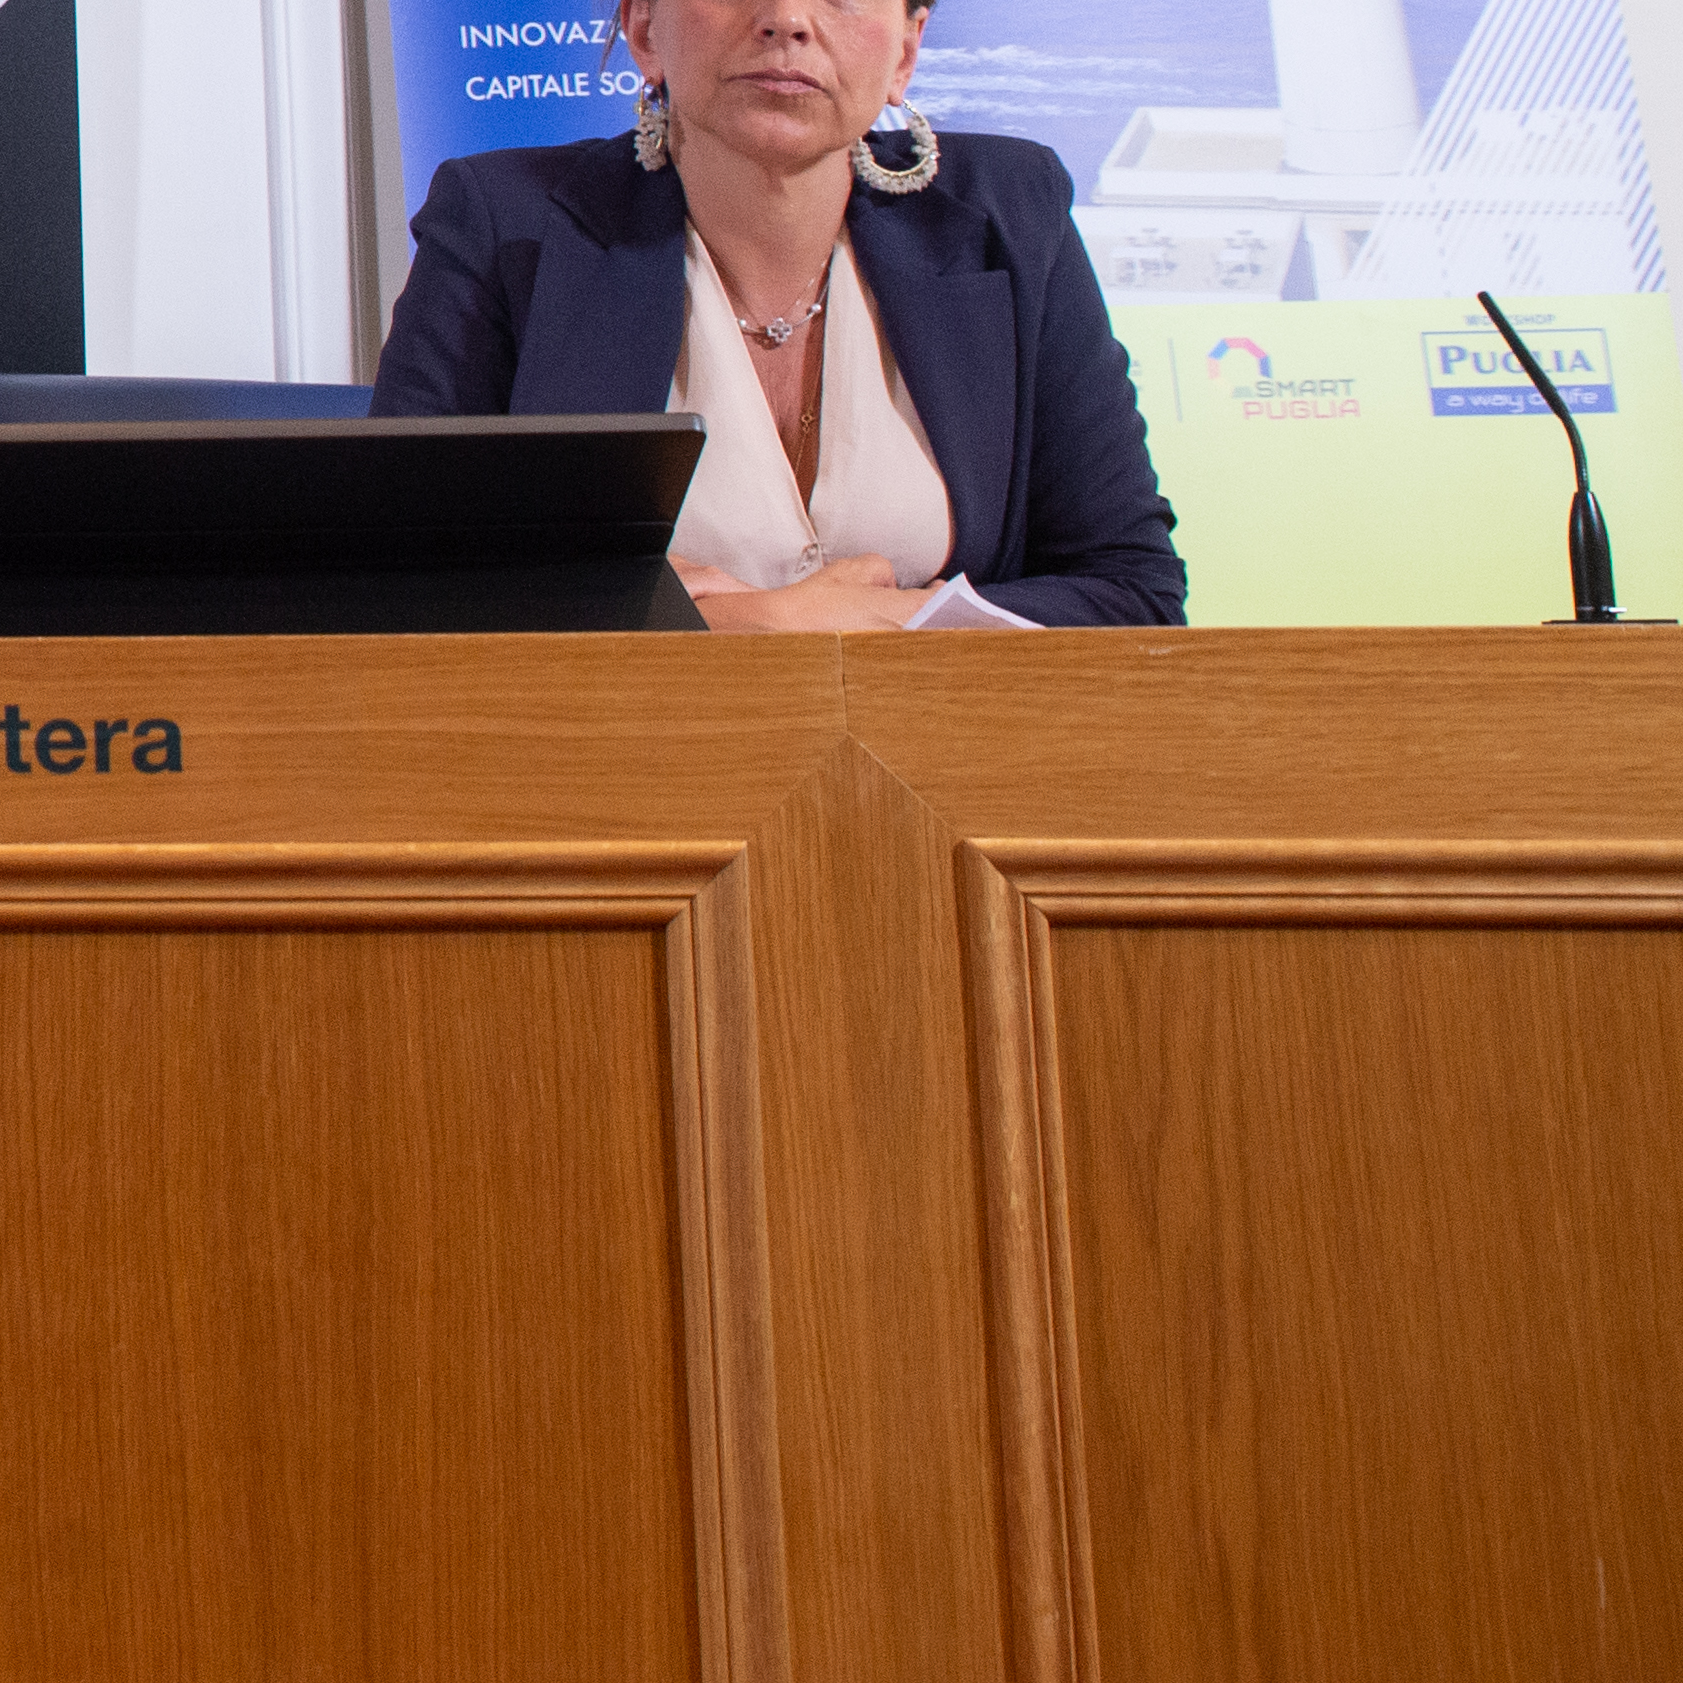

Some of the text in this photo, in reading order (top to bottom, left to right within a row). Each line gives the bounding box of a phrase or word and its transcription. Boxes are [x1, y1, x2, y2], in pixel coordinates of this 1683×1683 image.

[465, 73, 590, 100] CAPITALE
[1256, 379, 1355, 397] SMART
[1243, 399, 1361, 419] PUGLIA
[1468, 392, 1523, 413] way
